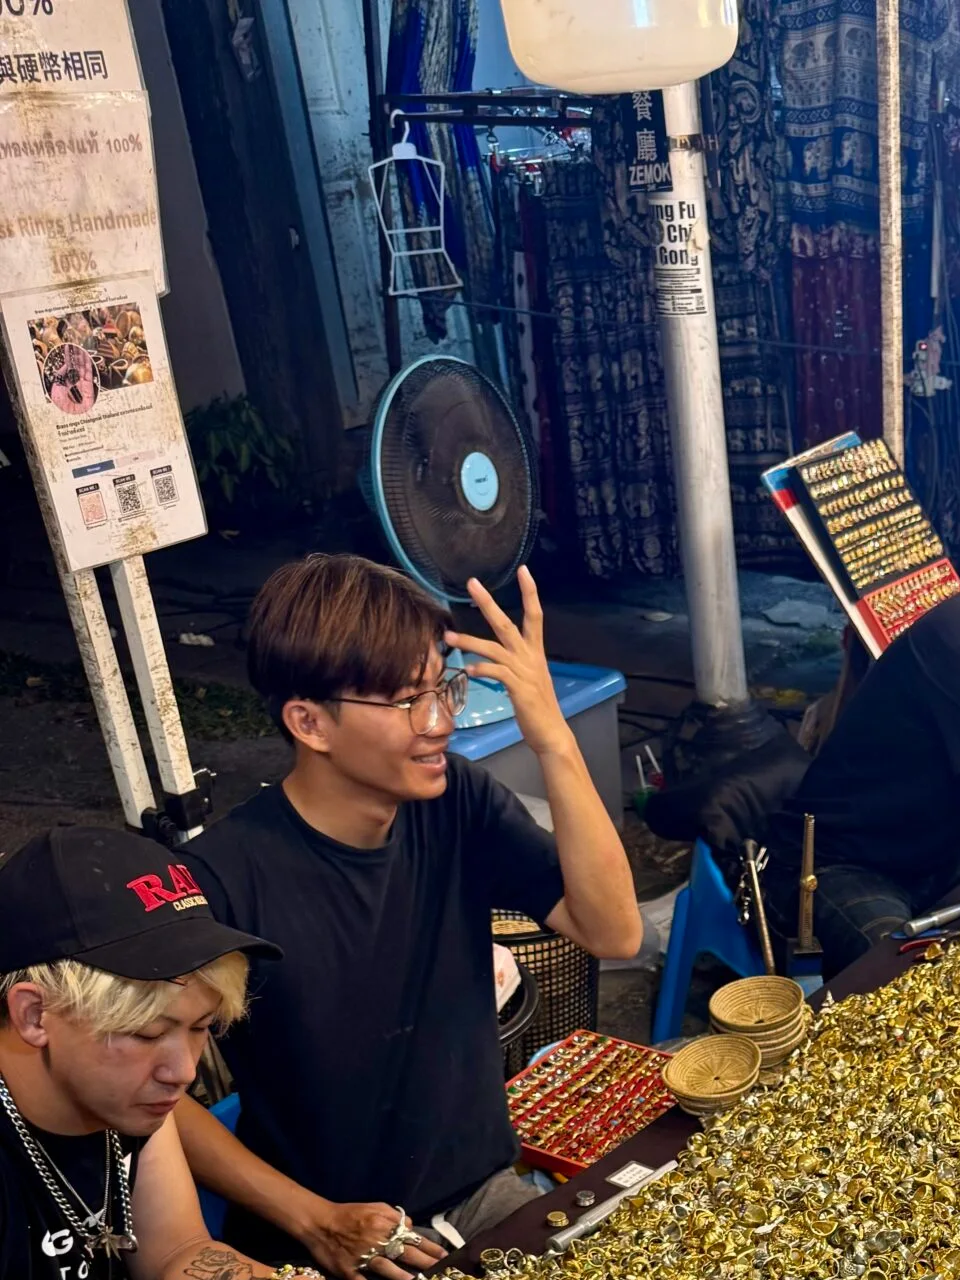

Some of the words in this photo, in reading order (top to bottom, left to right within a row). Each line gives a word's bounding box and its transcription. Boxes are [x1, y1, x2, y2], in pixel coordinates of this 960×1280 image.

[105, 133, 143, 154] 100%
[69, 208, 156, 234] Handmade
[679, 201, 696, 220] Fu
